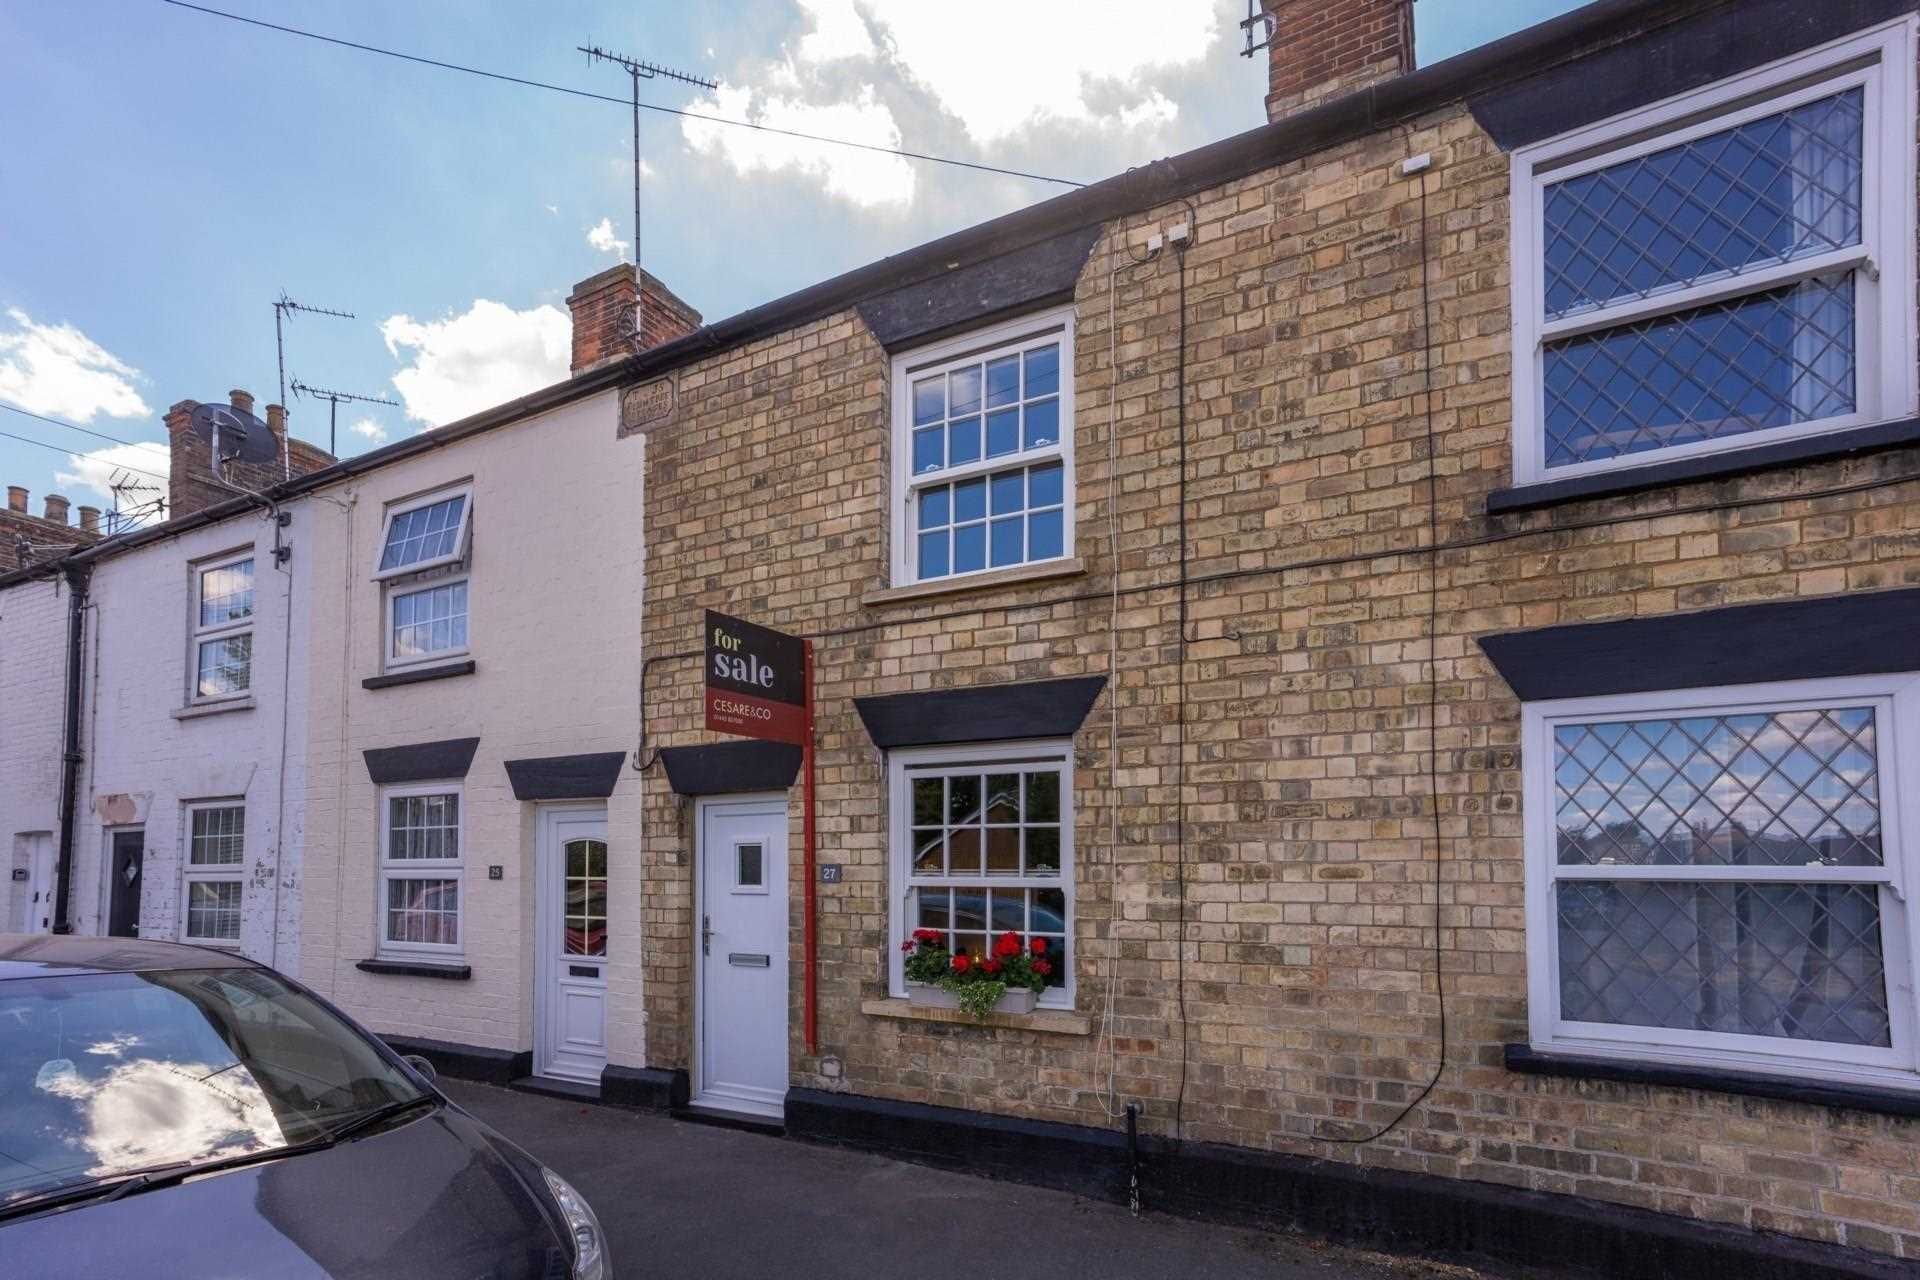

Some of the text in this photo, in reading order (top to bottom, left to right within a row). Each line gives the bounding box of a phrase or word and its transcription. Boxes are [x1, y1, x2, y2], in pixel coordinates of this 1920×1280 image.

[714, 627, 741, 651] for
[714, 653, 774, 688] sale
[713, 699, 771, 720] CESARE&CO
[823, 868, 836, 879] 27
